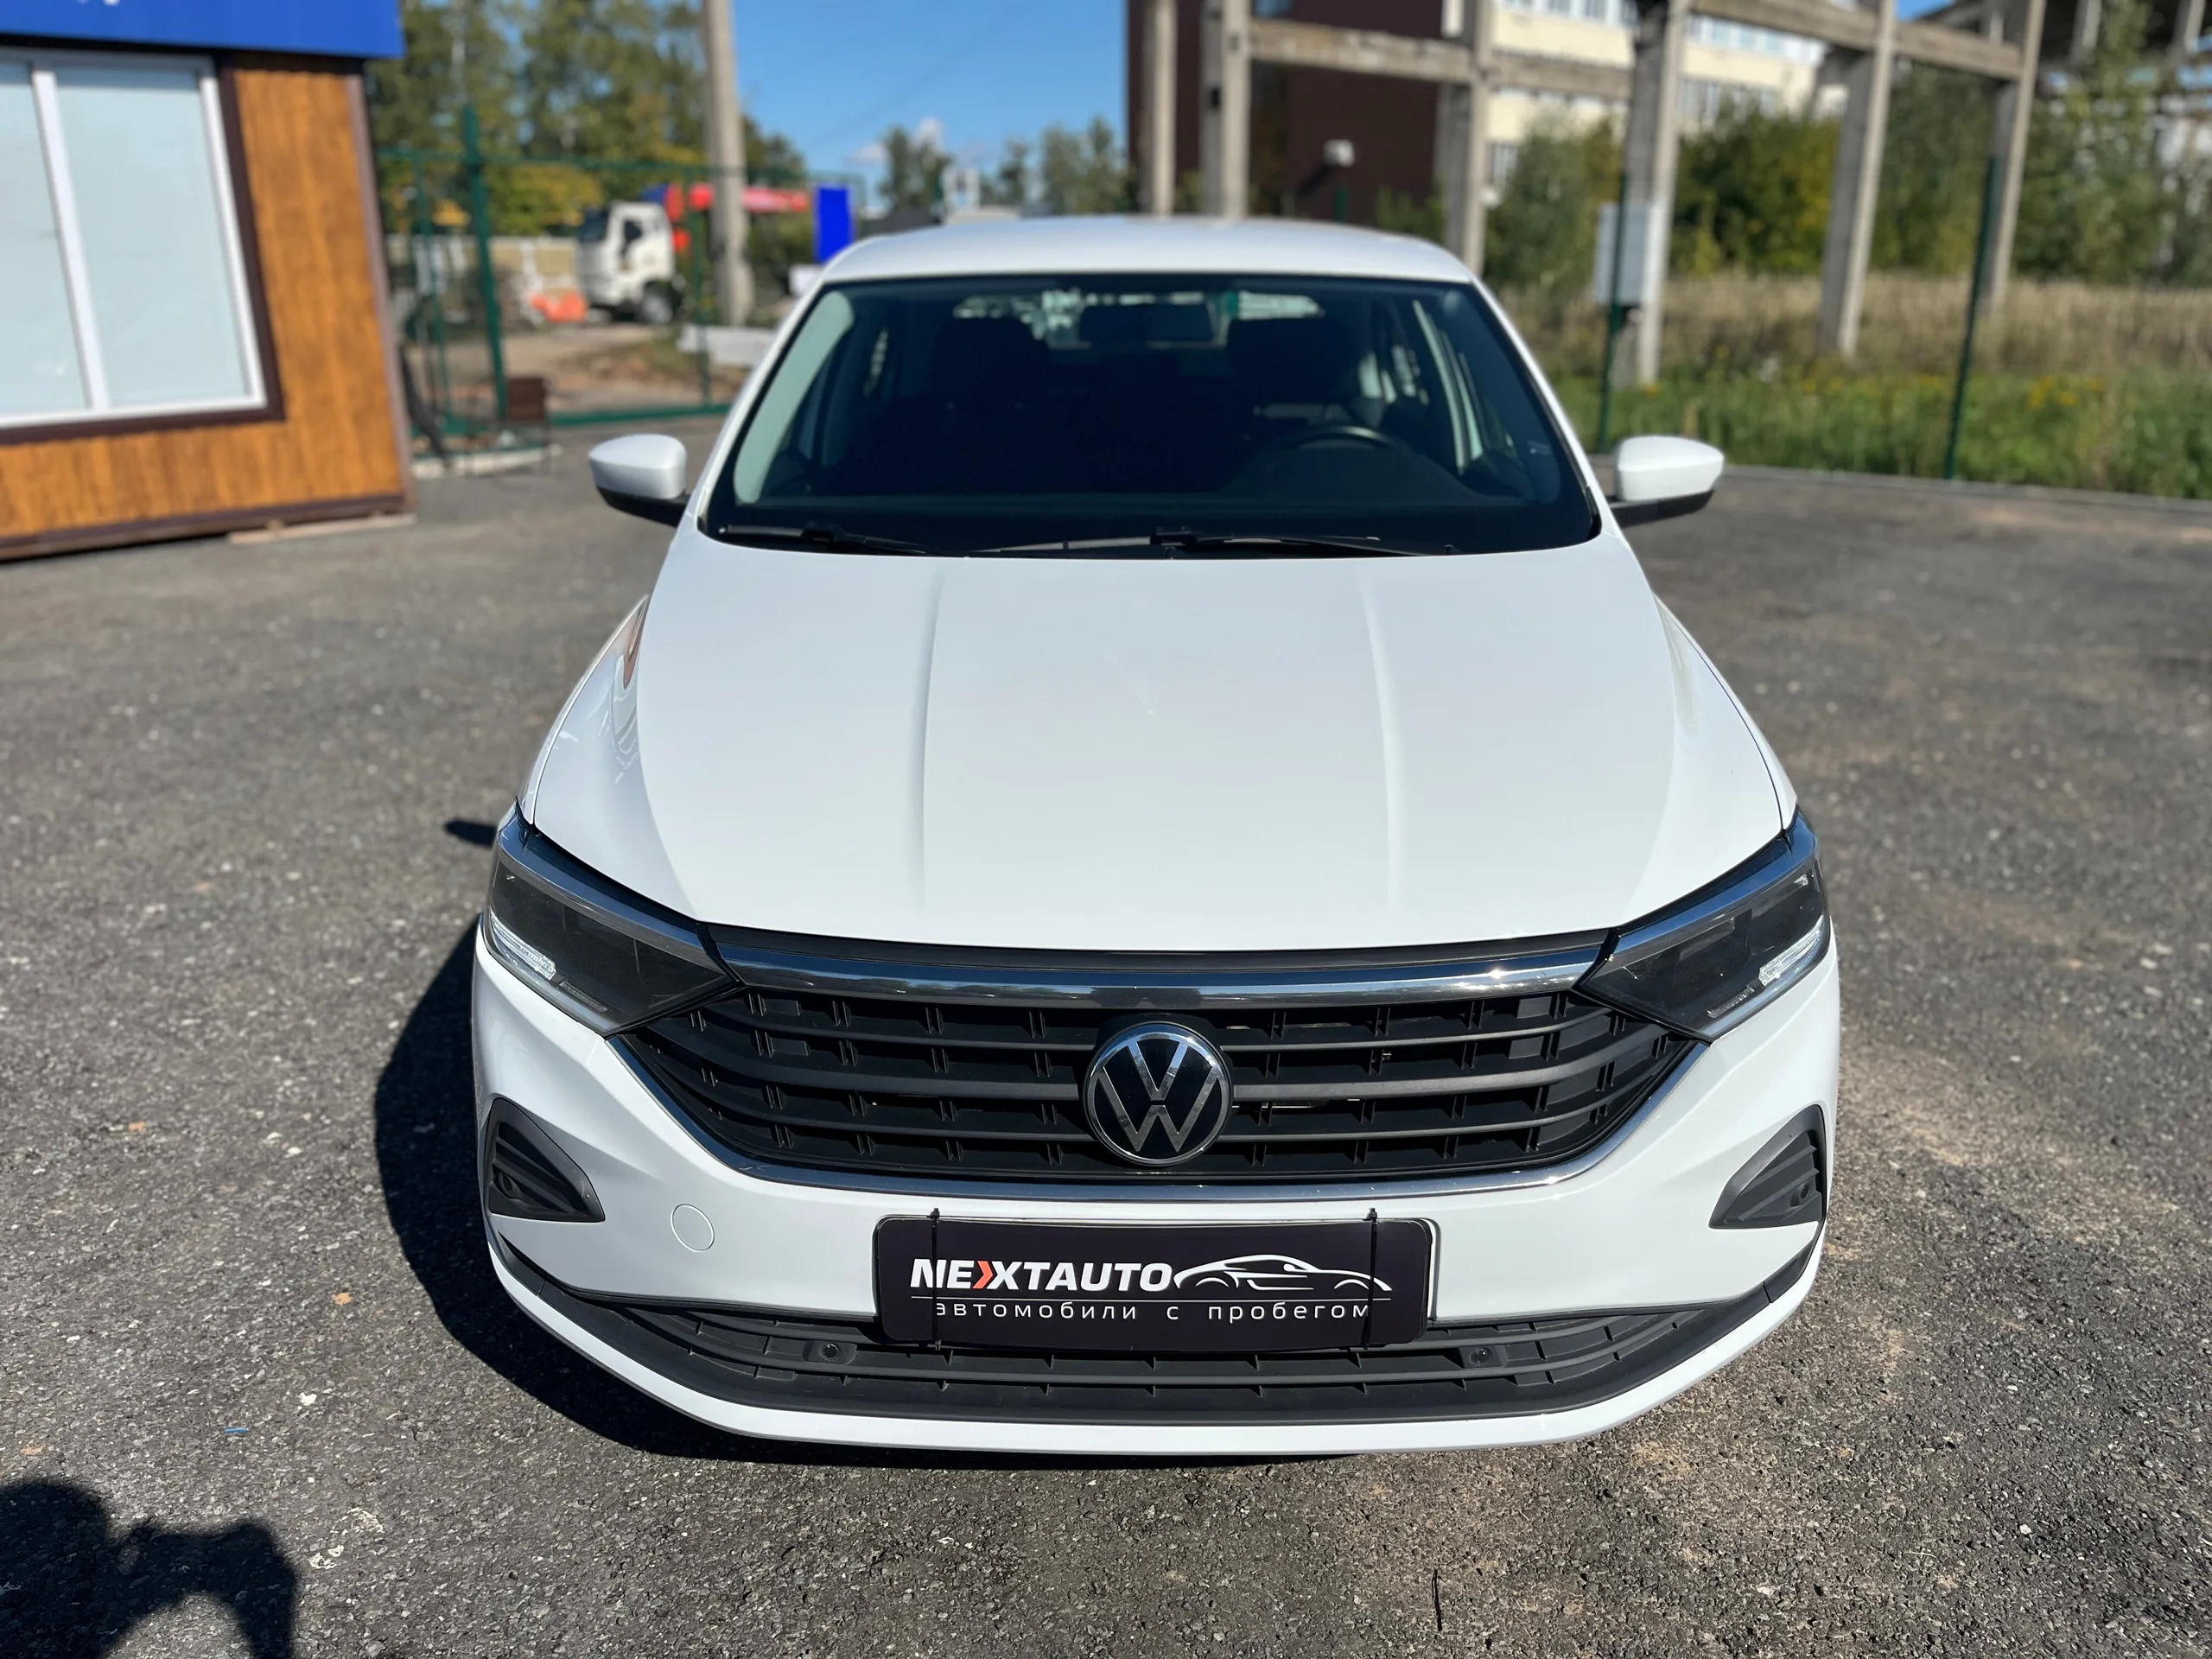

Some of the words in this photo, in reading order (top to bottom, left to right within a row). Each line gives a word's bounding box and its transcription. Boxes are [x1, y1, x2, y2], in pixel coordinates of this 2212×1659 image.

[1090, 1031, 1225, 1156] VW
[910, 1258, 1173, 1292] NEXTAUTO
[936, 1301, 1136, 1319] автомобили
[1166, 1306, 1179, 1320] с
[1208, 1301, 1370, 1324] пробегом
